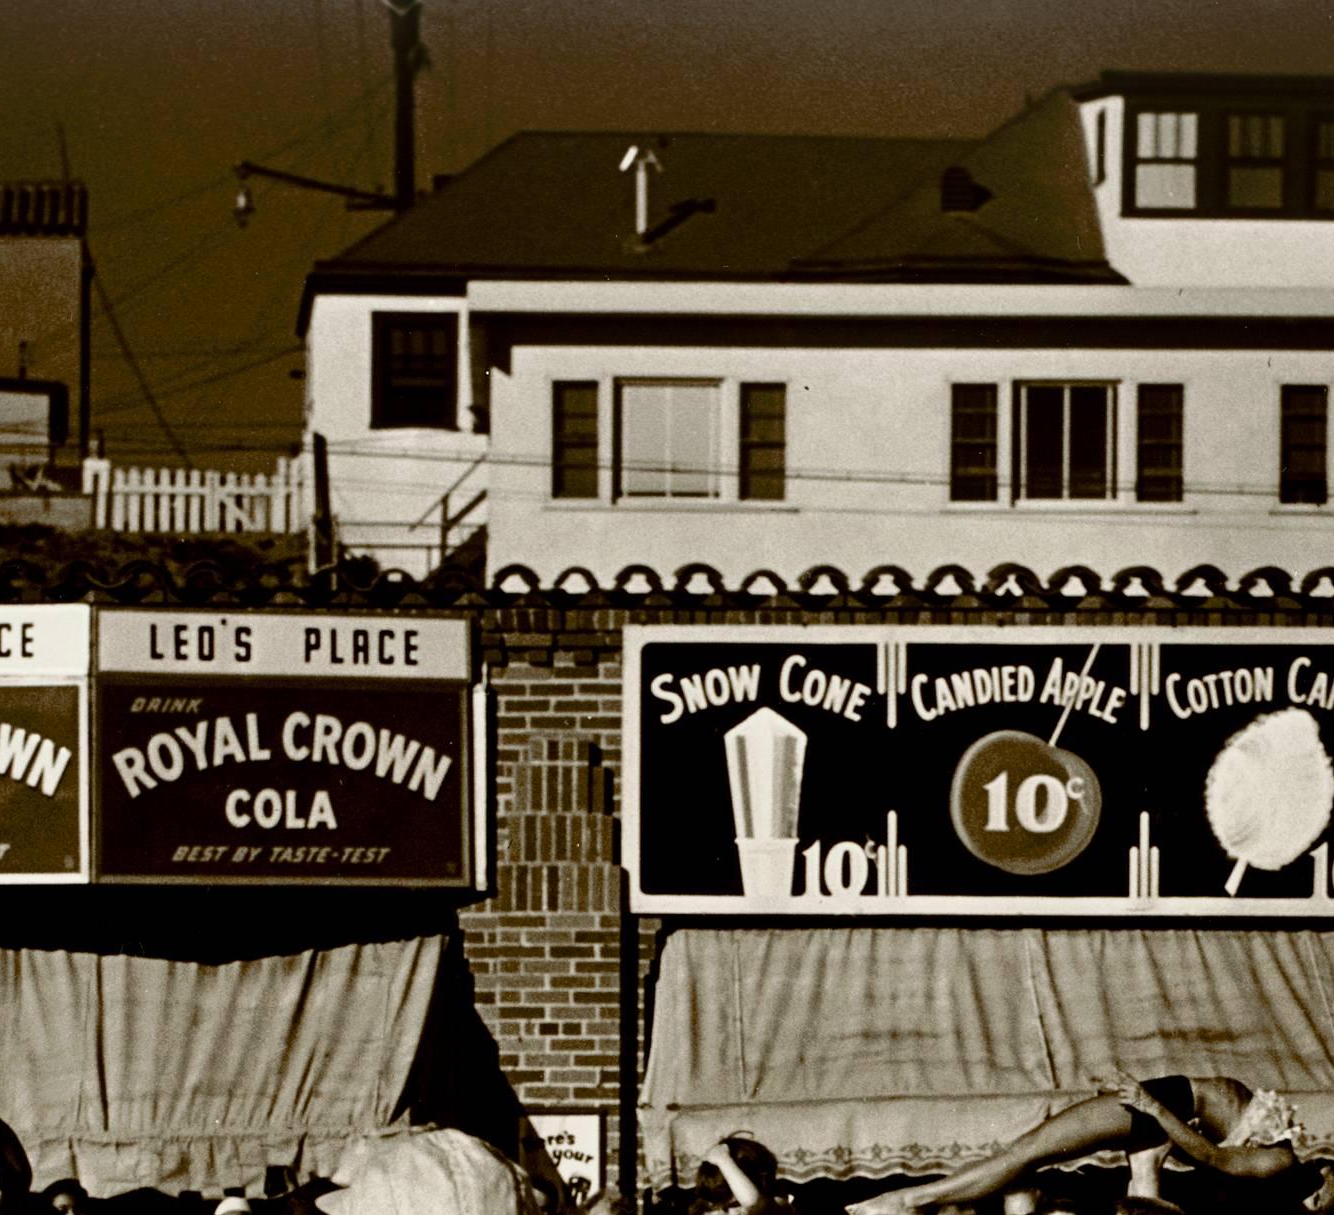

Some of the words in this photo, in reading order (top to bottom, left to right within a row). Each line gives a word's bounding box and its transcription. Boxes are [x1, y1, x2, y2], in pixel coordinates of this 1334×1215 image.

[149, 617, 252, 663] LEO'S
[304, 626, 419, 666] PLACE
[130, 697, 204, 713] DRINK
[650, 664, 762, 724] SNOW
[779, 654, 872, 722] CONE
[911, 664, 1036, 721] CANDIED
[1039, 656, 1128, 725] APPLE
[1165, 666, 1274, 719] COTTON
[112, 712, 272, 799] ROYAL
[281, 710, 453, 802] CROWN
[224, 787, 339, 830] COLA
[171, 845, 230, 863] BEST
[232, 846, 263, 863] BY
[268, 846, 391, 864] TASTE-TEST
[553, 1150, 594, 1168] your
